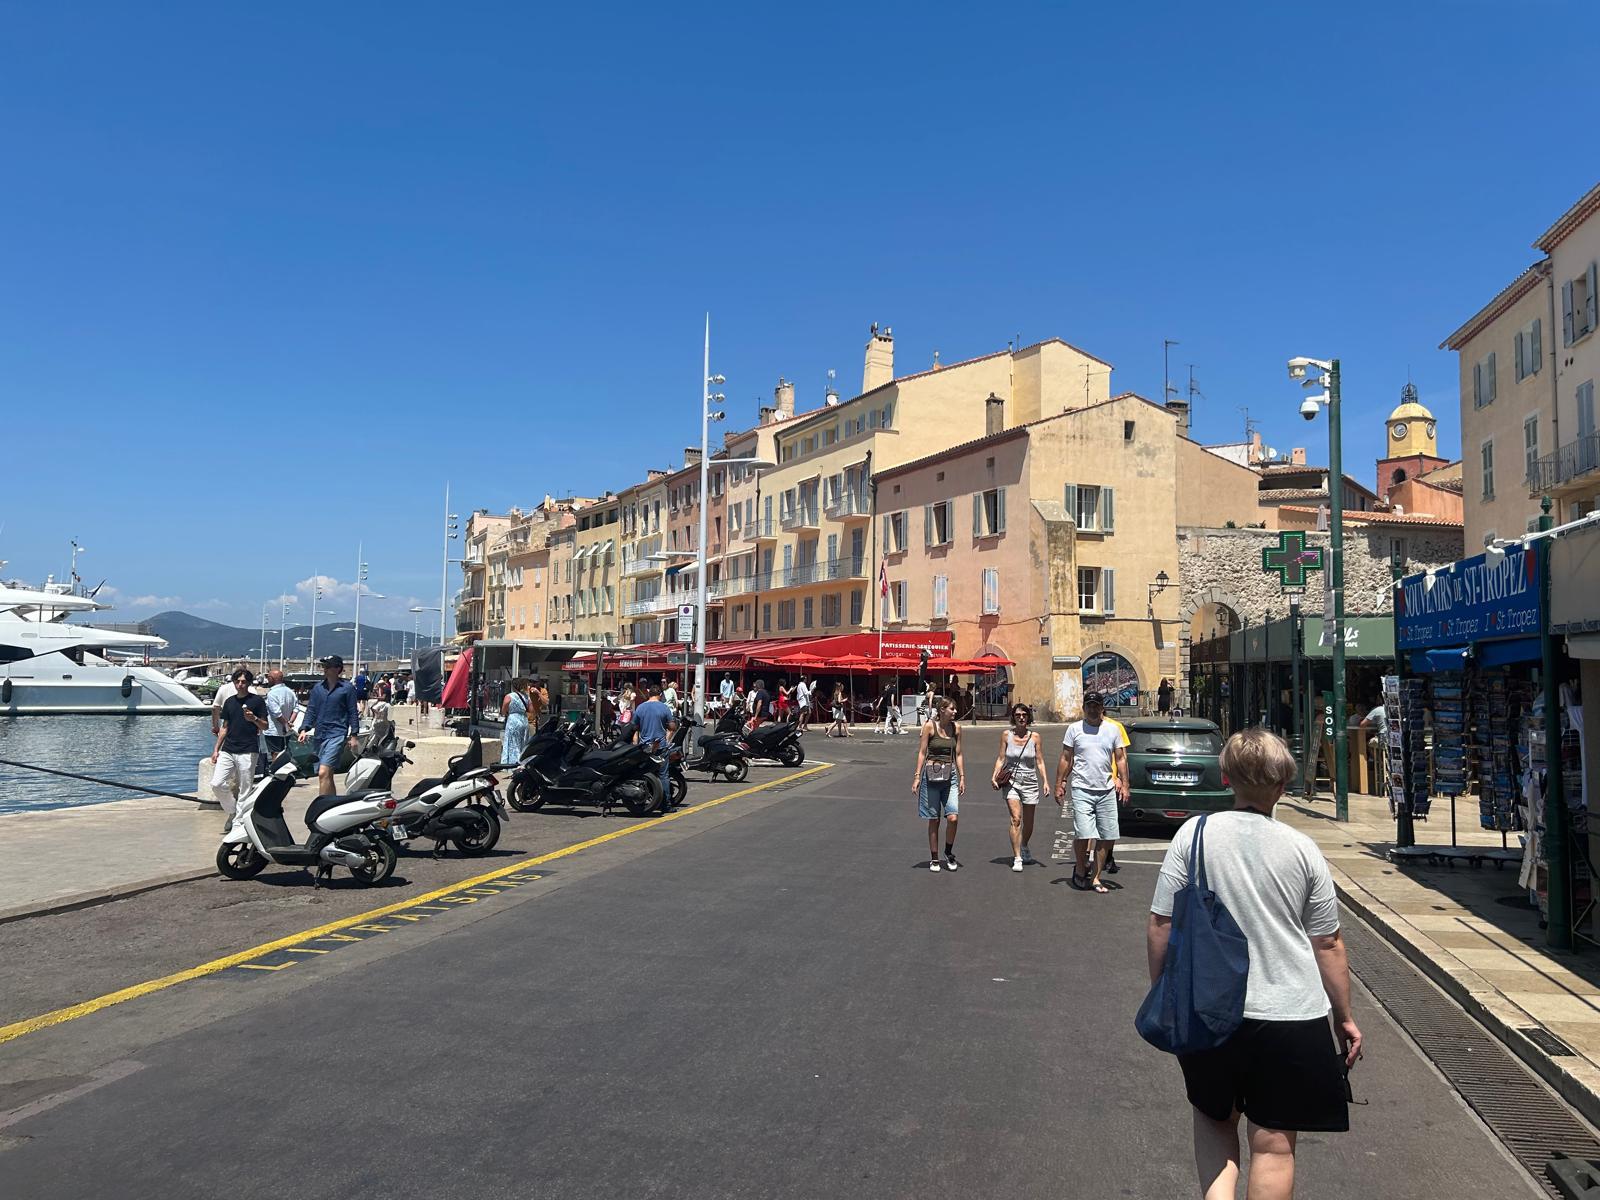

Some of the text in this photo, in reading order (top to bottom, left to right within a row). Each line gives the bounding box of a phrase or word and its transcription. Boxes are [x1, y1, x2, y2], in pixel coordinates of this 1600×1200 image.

[1453, 577, 1463, 602] DE
[1464, 550, 1527, 607] ST-TROPEZ
[1446, 619, 1455, 637] St
[1456, 617, 1479, 639] Tropez
[1496, 610, 1506, 630] St
[1507, 608, 1537, 633] Tropez
[1325, 706, 1334, 736] SOS
[236, 872, 544, 972] LIVRAISONS
